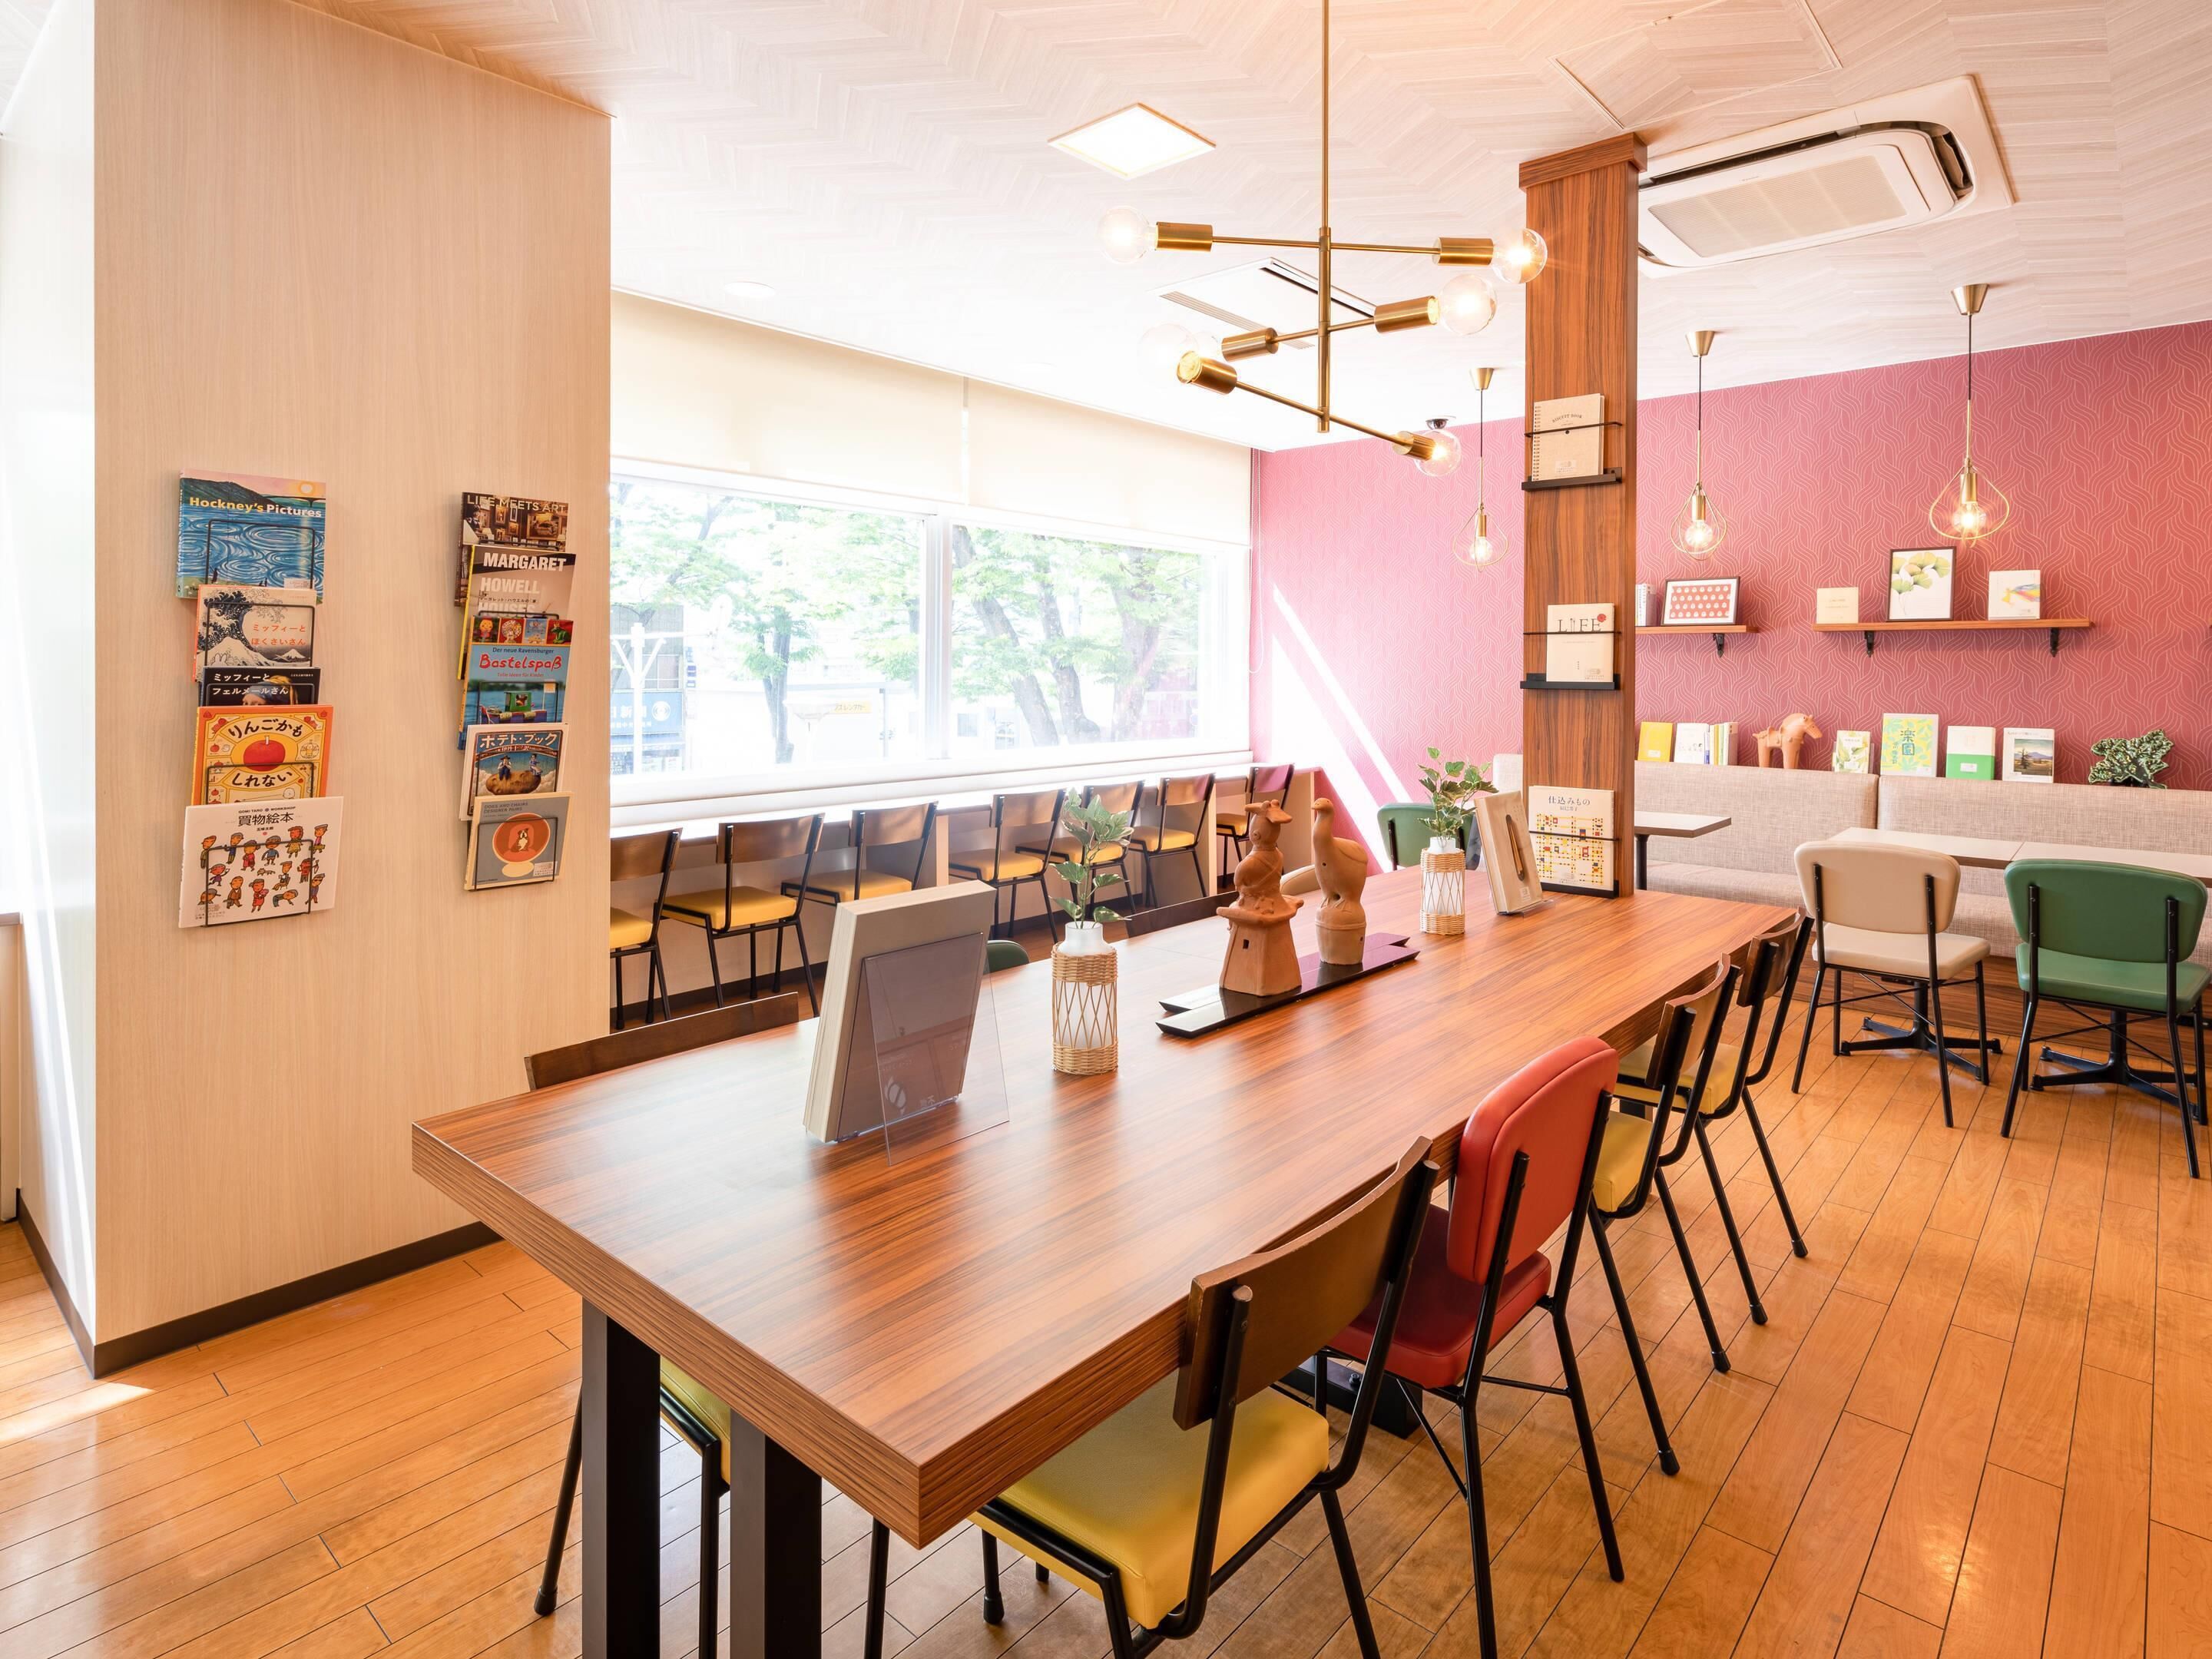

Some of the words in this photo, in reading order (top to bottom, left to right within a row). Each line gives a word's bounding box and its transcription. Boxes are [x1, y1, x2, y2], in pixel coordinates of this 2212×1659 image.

[190, 497, 264, 514] Hockney's
[267, 504, 323, 518] Pictures
[467, 495, 495, 507] LIFE
[499, 498, 540, 512] MEETS
[541, 504, 566, 513] ART
[483, 551, 567, 572] MARGARET
[480, 577, 541, 594] HOWELL
[253, 623, 306, 633] ミッフィーと
[251, 637, 306, 646] ほくさいさん
[479, 654, 563, 673] Bastelspaß
[214, 673, 270, 682] ミッフィーと
[212, 687, 290, 695] フェルメールさん
[228, 719, 303, 739] りんごかも
[231, 770, 293, 788] しれない
[1548, 795, 1591, 806] 仕込みもの
[238, 812, 294, 827] 買物絵本
